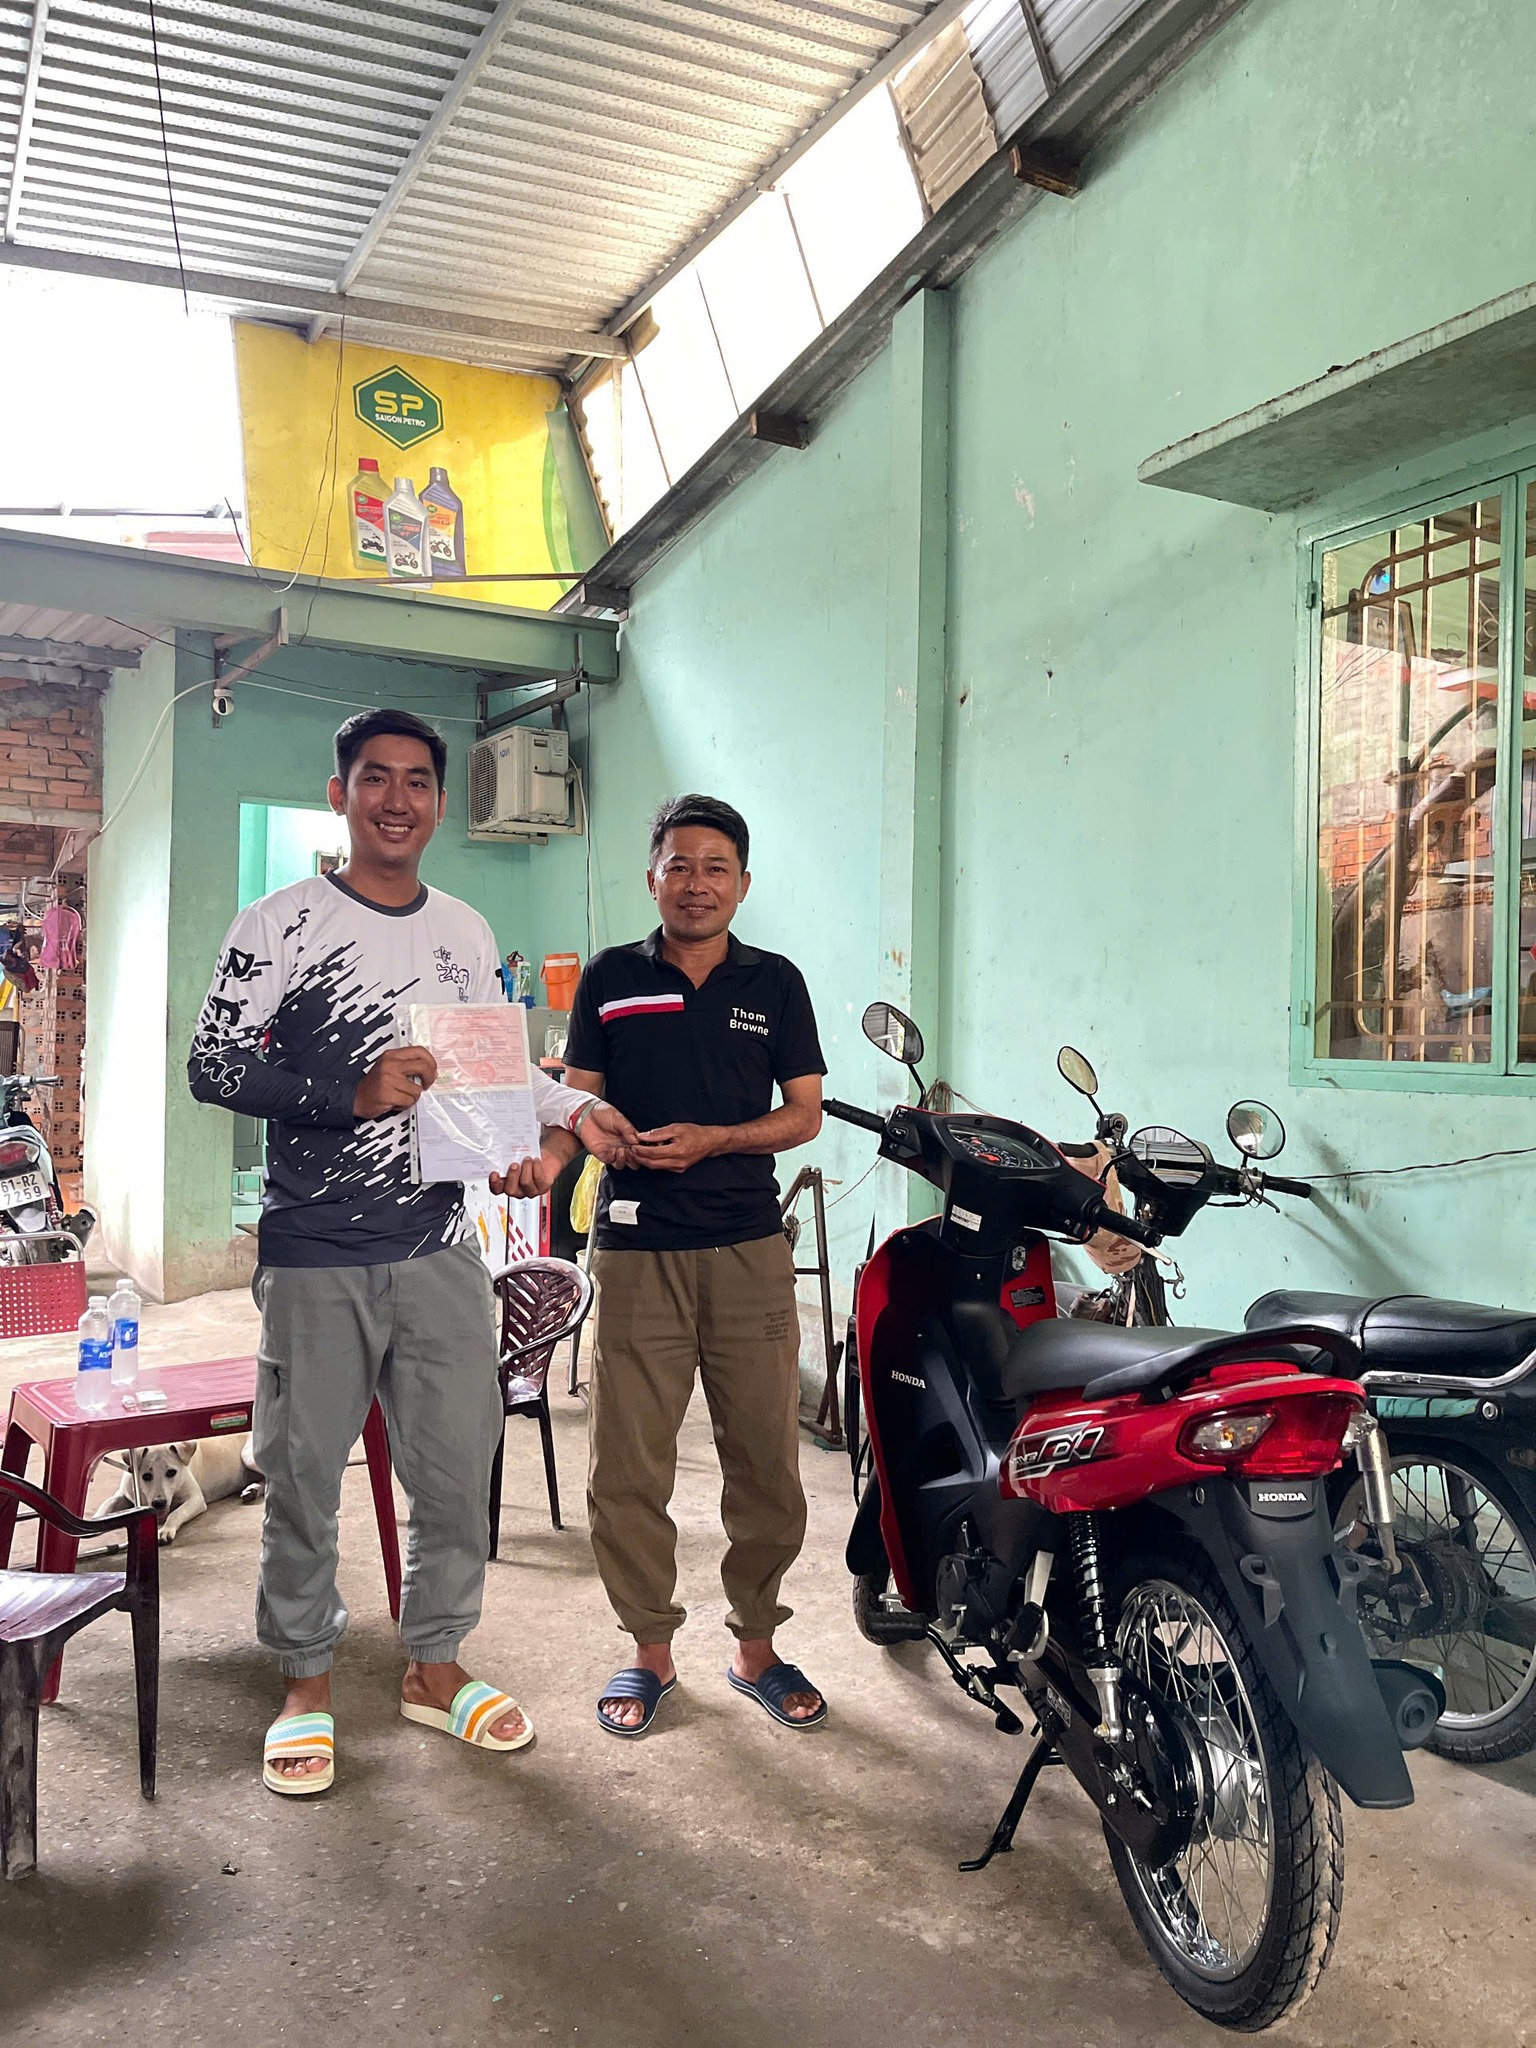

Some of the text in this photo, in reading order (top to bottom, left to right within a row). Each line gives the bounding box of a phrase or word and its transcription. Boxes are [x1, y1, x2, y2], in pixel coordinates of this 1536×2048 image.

[374, 390, 424, 416] SP
[375, 413, 426, 427] SAIGON PETRO
[732, 1007, 766, 1023] Thom
[730, 1018, 769, 1036] Browne
[891, 1369, 927, 1389] HONDA
[1258, 1492, 1308, 1502] HONDA
